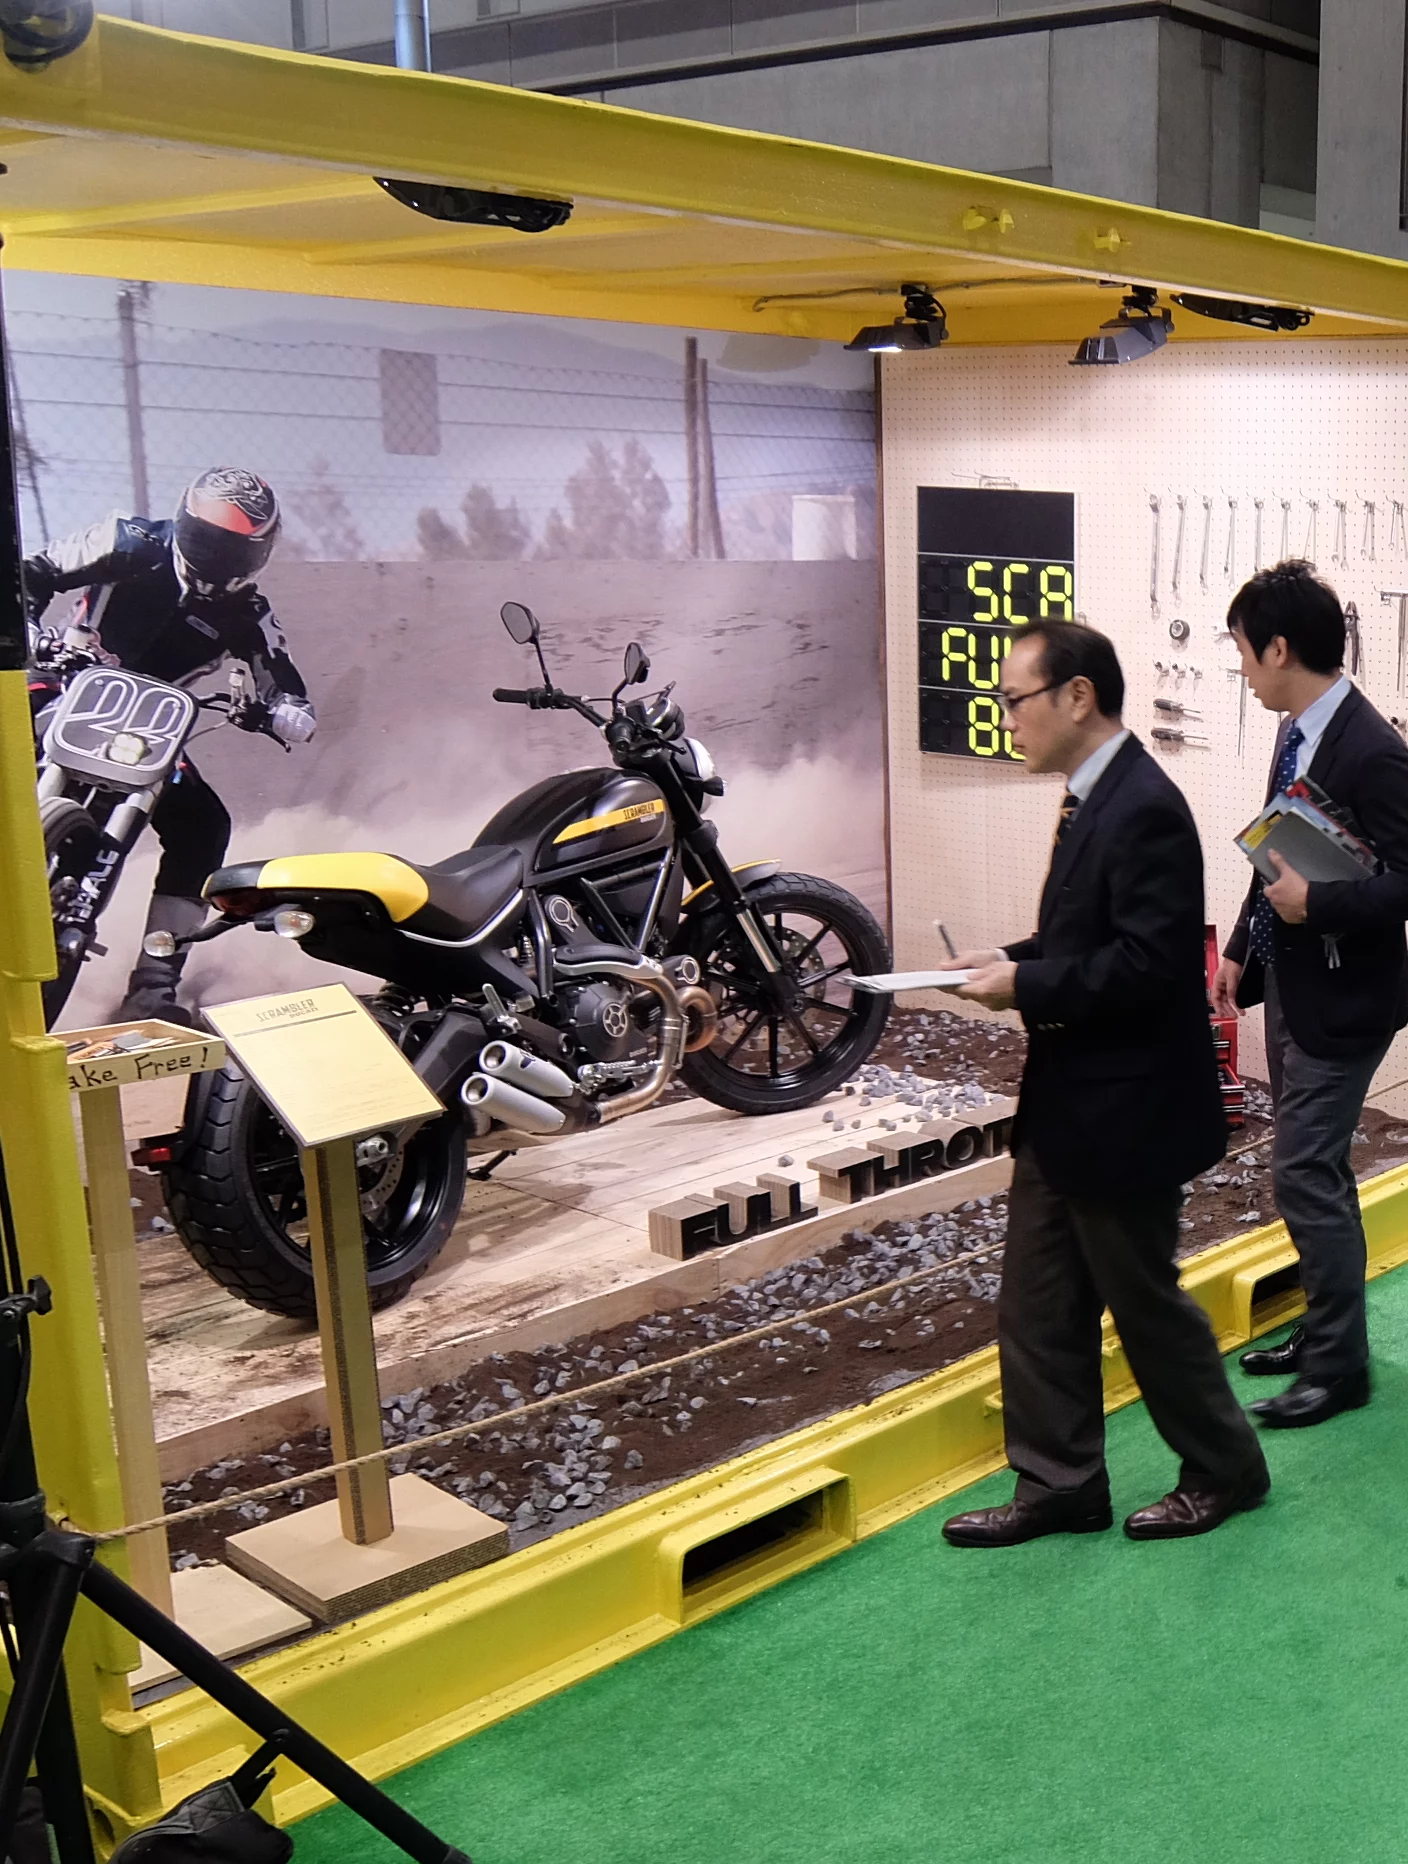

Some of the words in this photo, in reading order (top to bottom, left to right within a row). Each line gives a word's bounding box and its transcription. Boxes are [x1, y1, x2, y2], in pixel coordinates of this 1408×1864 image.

[967, 560, 1073, 625] SCA
[941, 627, 1013, 690] FU
[255, 998, 315, 1022] SCRAMBLER
[67, 1064, 118, 1090] ake
[654, 1175, 819, 1261] FULL
[808, 1110, 1014, 1205] THROT
